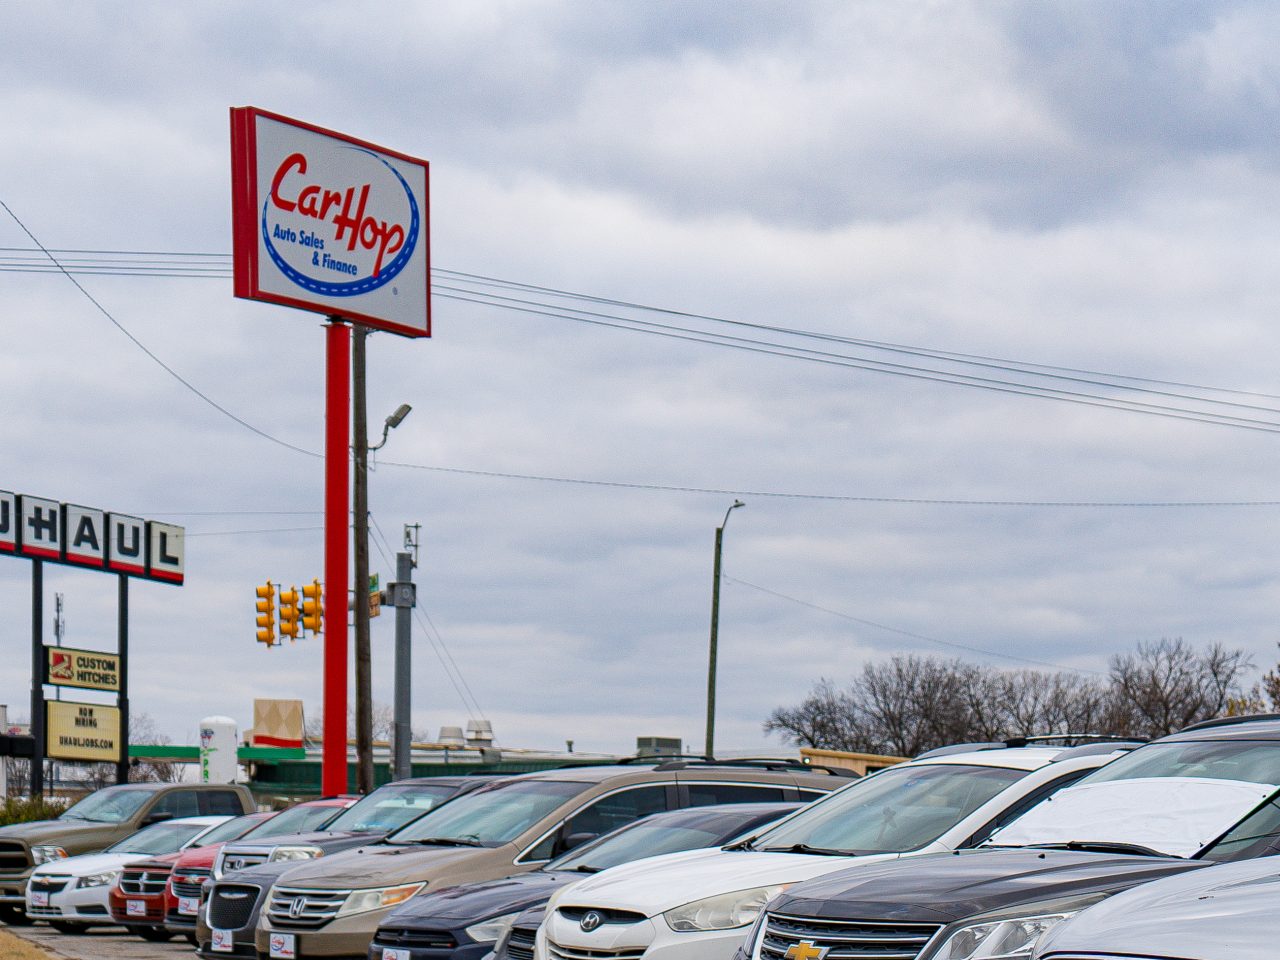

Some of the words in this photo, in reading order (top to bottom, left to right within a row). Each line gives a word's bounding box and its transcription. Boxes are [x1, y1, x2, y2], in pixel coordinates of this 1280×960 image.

[271, 153, 404, 278] CarHop
[273, 223, 297, 243] Auto
[299, 230, 324, 250] Sales
[312, 250, 320, 267] &
[322, 252, 358, 276] Finance
[76, 656, 116, 672] CUSTOM
[76, 671, 117, 686] HITCHES
[75, 716, 97, 729] HIRING
